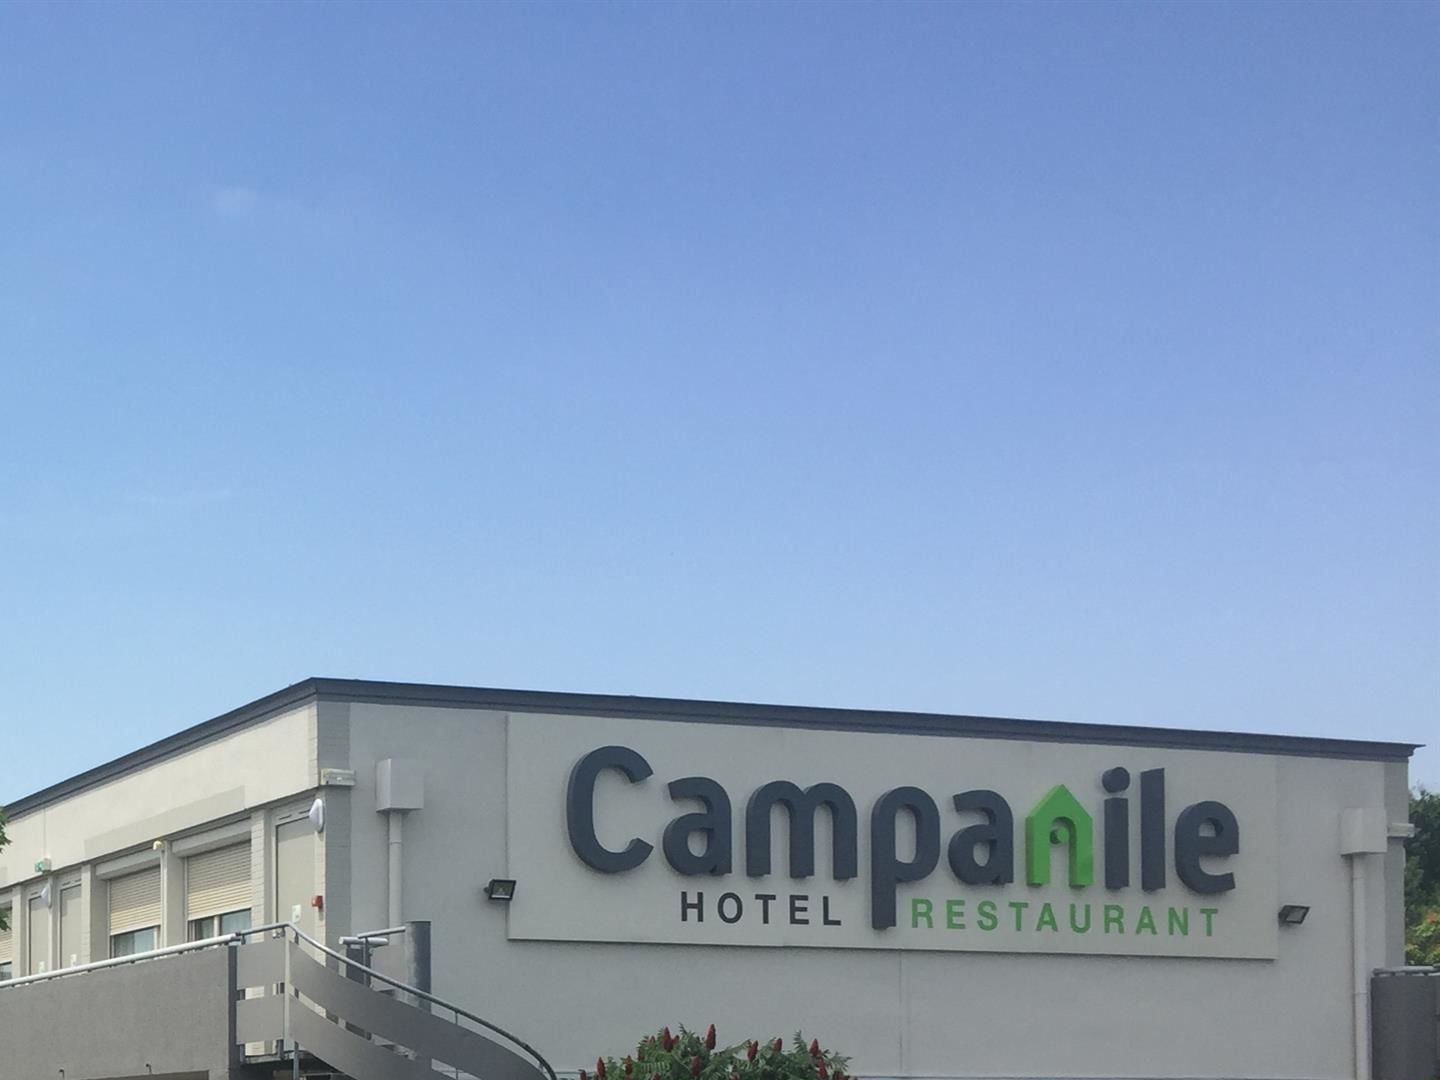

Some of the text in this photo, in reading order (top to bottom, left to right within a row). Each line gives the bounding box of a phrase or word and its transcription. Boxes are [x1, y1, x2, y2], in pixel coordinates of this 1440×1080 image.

[566, 745, 1240, 930] Campanile
[680, 890, 1219, 938] HOTEL RESTAURANT
